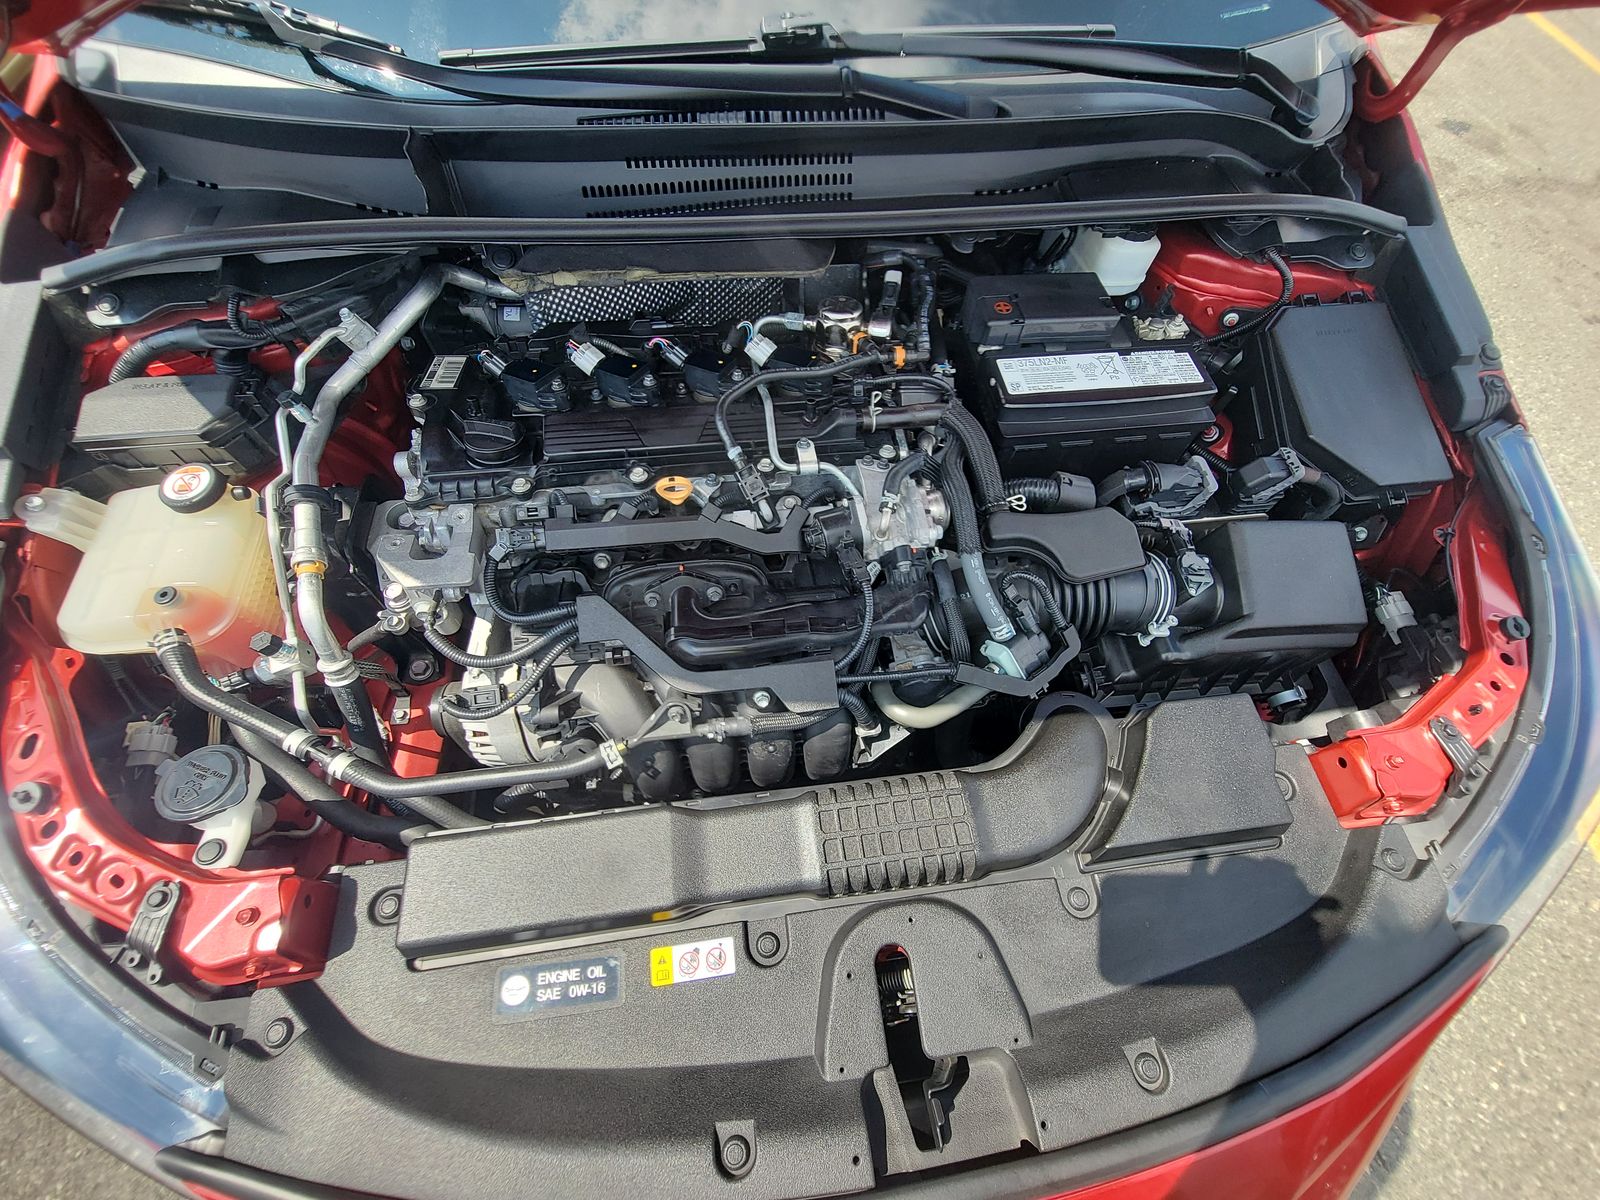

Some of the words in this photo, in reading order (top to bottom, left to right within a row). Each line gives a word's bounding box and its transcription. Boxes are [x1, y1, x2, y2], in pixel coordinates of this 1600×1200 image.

[1018, 357, 1068, 368] 375LN2-MF
[536, 967, 581, 986] ENGINE
[586, 965, 607, 979] OIL
[536, 987, 561, 1002] SAE
[569, 982, 606, 999] 0W-16
